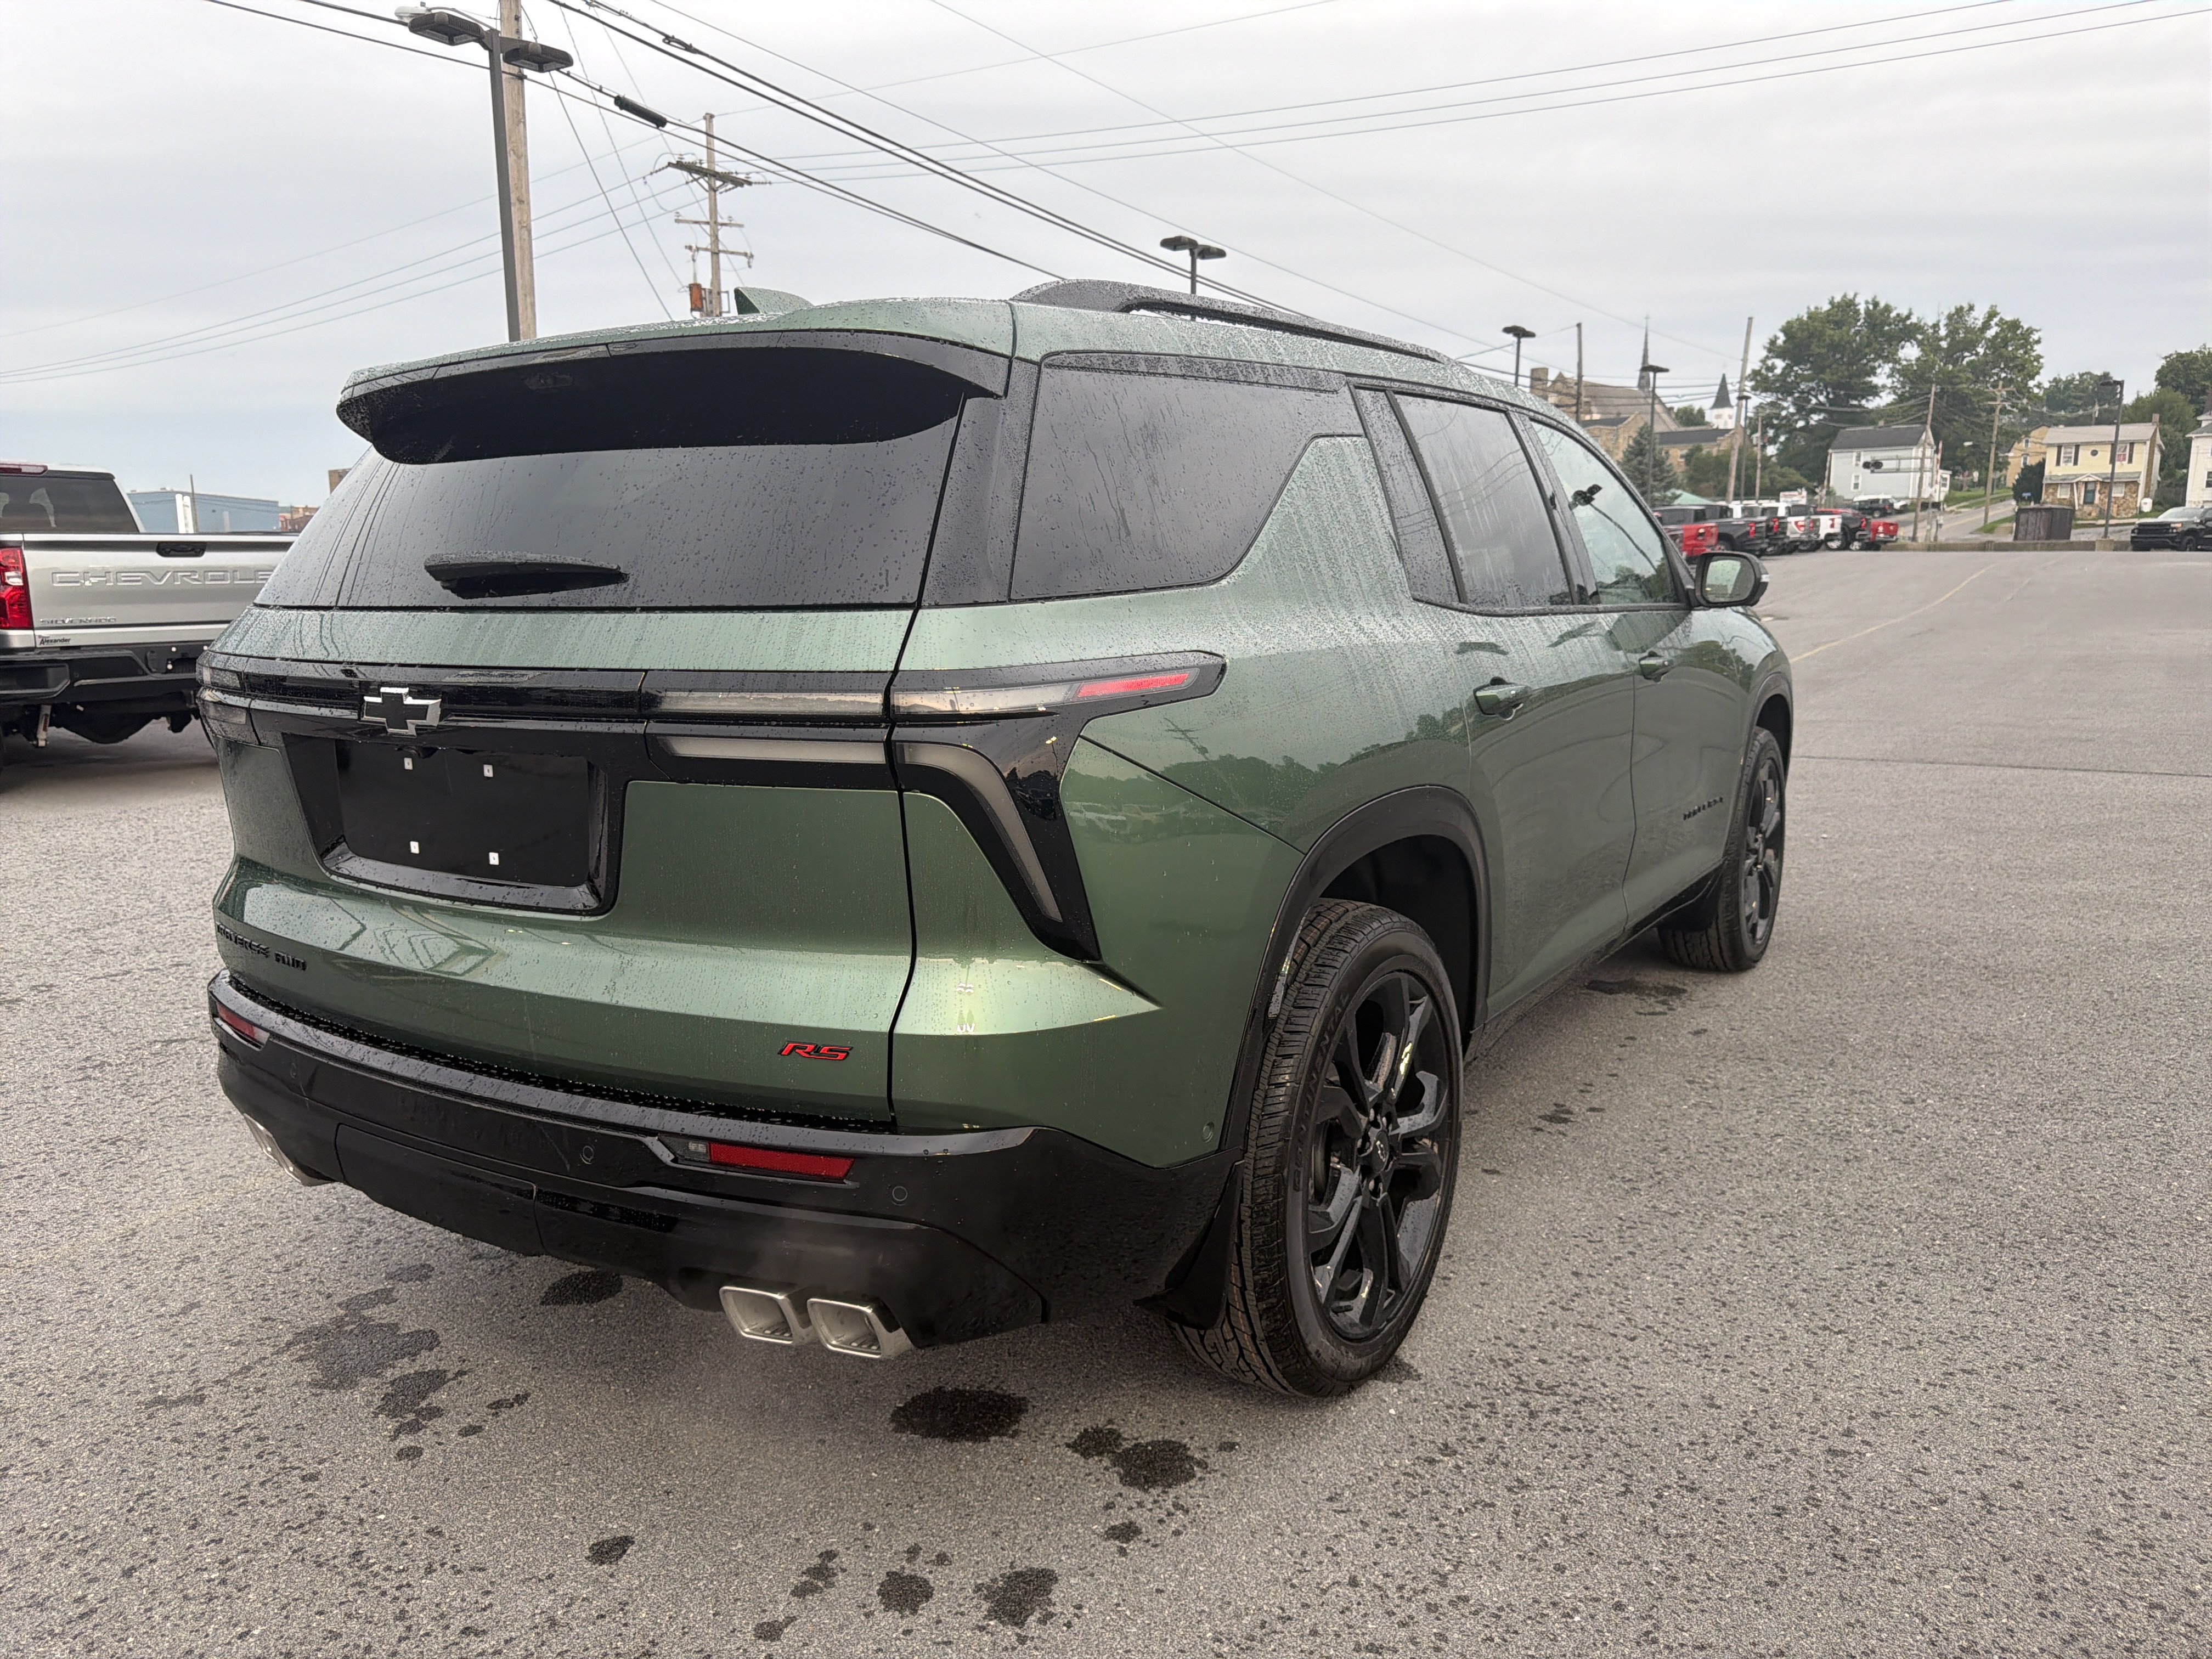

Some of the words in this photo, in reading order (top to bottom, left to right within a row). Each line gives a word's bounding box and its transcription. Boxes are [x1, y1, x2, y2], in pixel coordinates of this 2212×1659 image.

[52, 570, 274, 586] CHEVROLE
[39, 637, 71, 646] Alexander
[777, 1041, 853, 1061] RS
